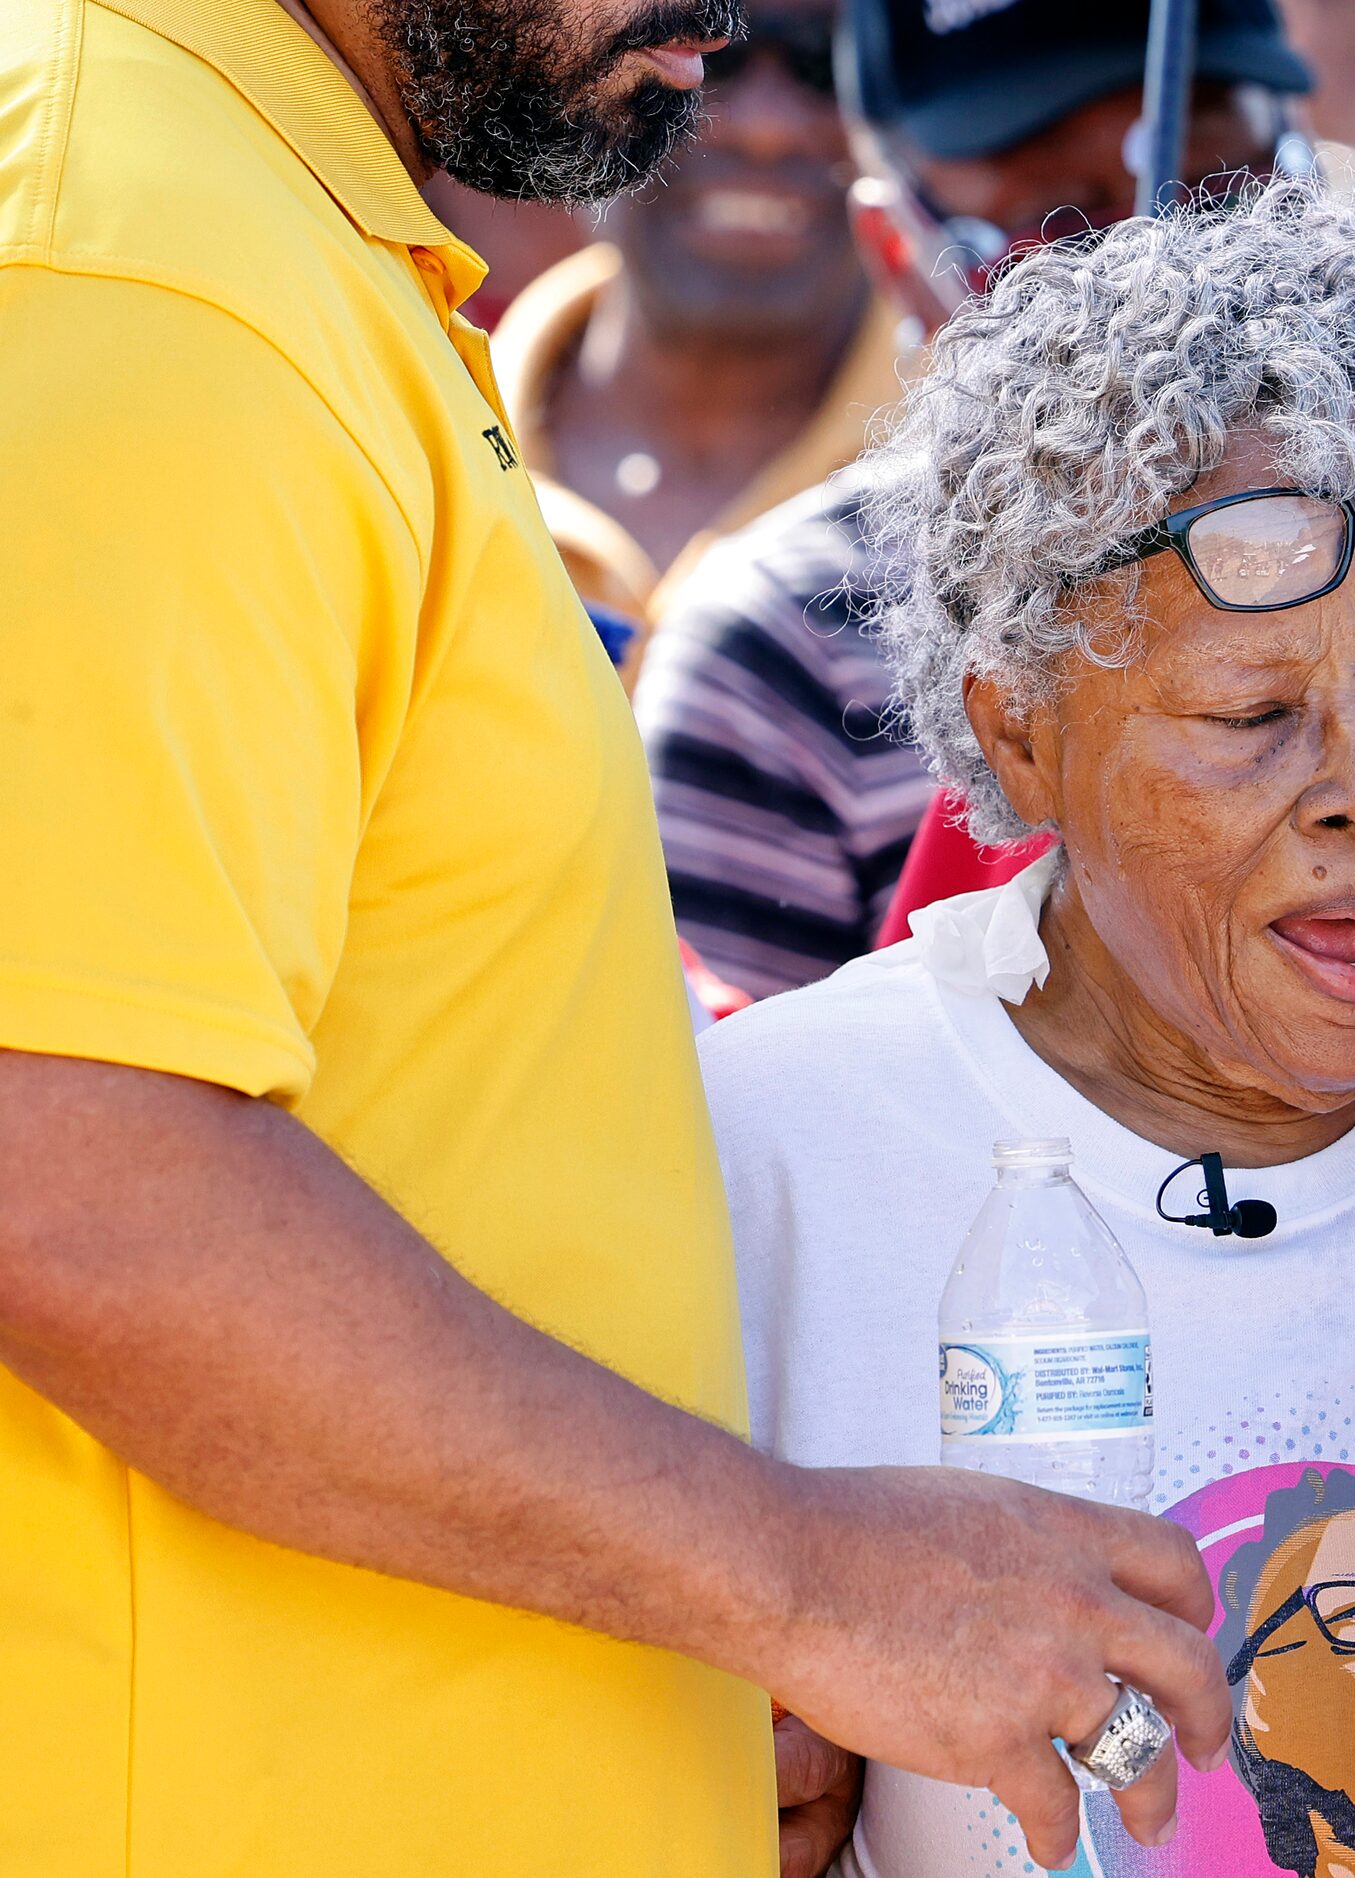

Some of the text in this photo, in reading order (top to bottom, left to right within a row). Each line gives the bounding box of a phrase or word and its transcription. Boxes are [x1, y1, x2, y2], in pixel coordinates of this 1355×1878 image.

[957, 1368, 986, 1382] Purified
[1035, 1368, 1079, 1377] DISTRIBUTED
[945, 1380, 987, 1399] Drinking
[1035, 1391, 1066, 1401] PURIFIED
[1067, 1390, 1078, 1400] BY:
[953, 1397, 988, 1411] Water
